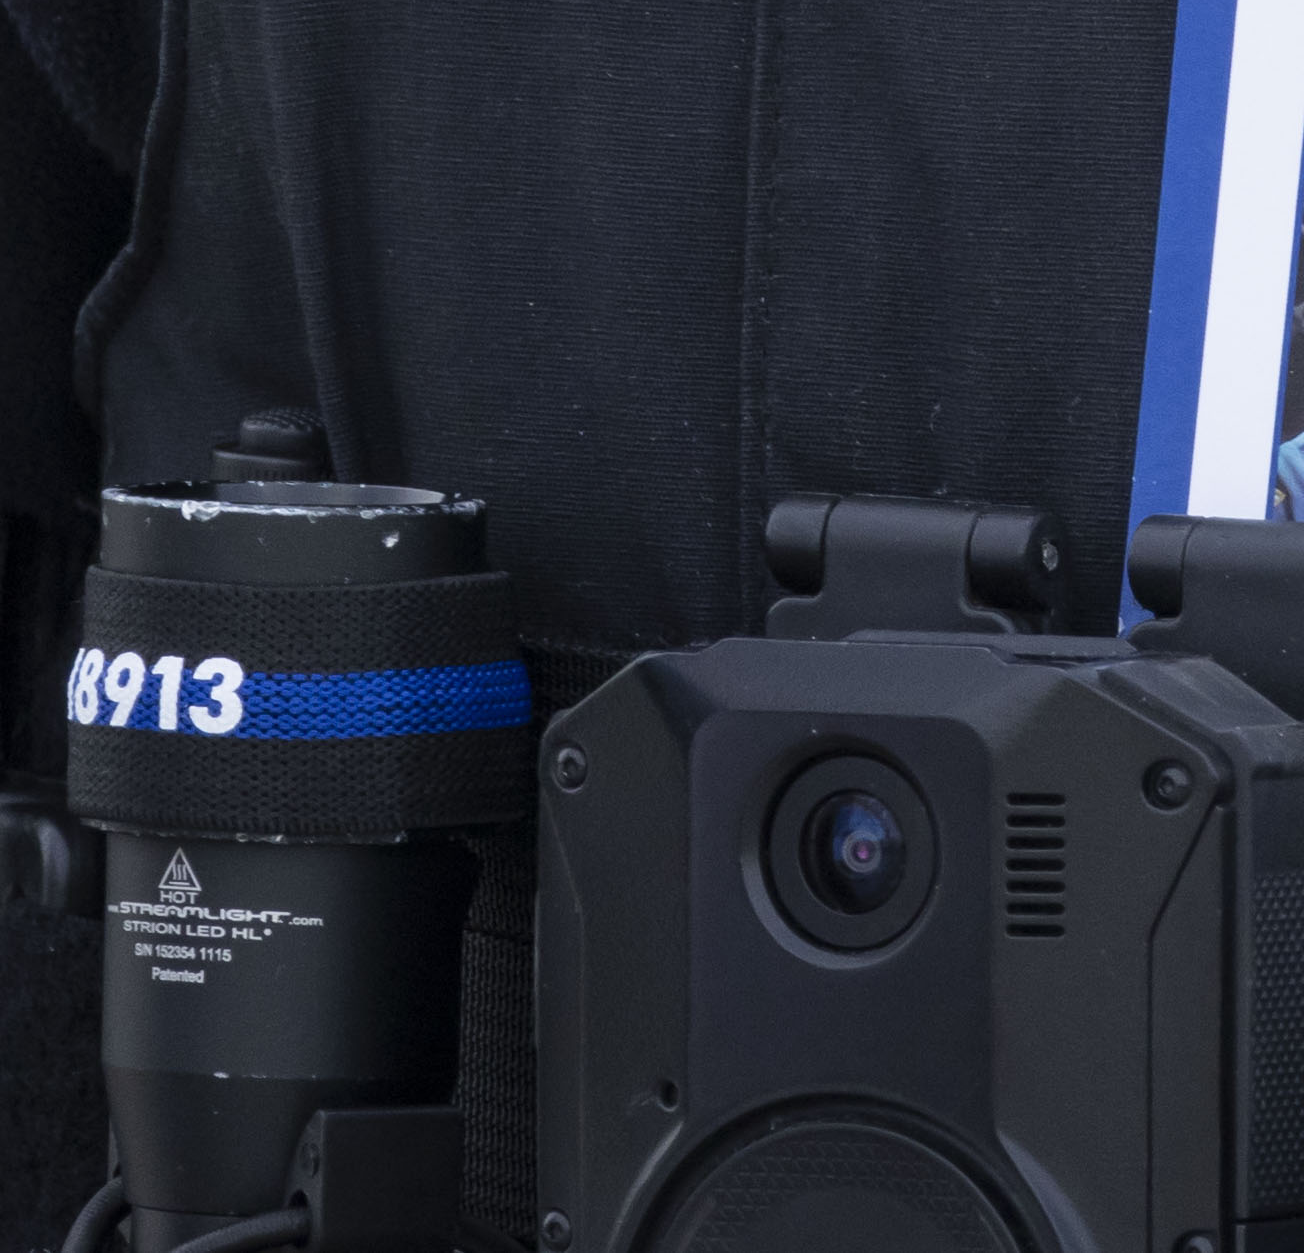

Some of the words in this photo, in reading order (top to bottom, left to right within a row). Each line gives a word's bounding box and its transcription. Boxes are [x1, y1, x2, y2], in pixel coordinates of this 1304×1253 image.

[159, 890, 199, 904] HOT
[122, 919, 181, 935] STRION
[186, 924, 226, 938] LED
[155, 944, 196, 960] 152354
[200, 946, 232, 962] 1115
[151, 966, 205, 983] Patented
